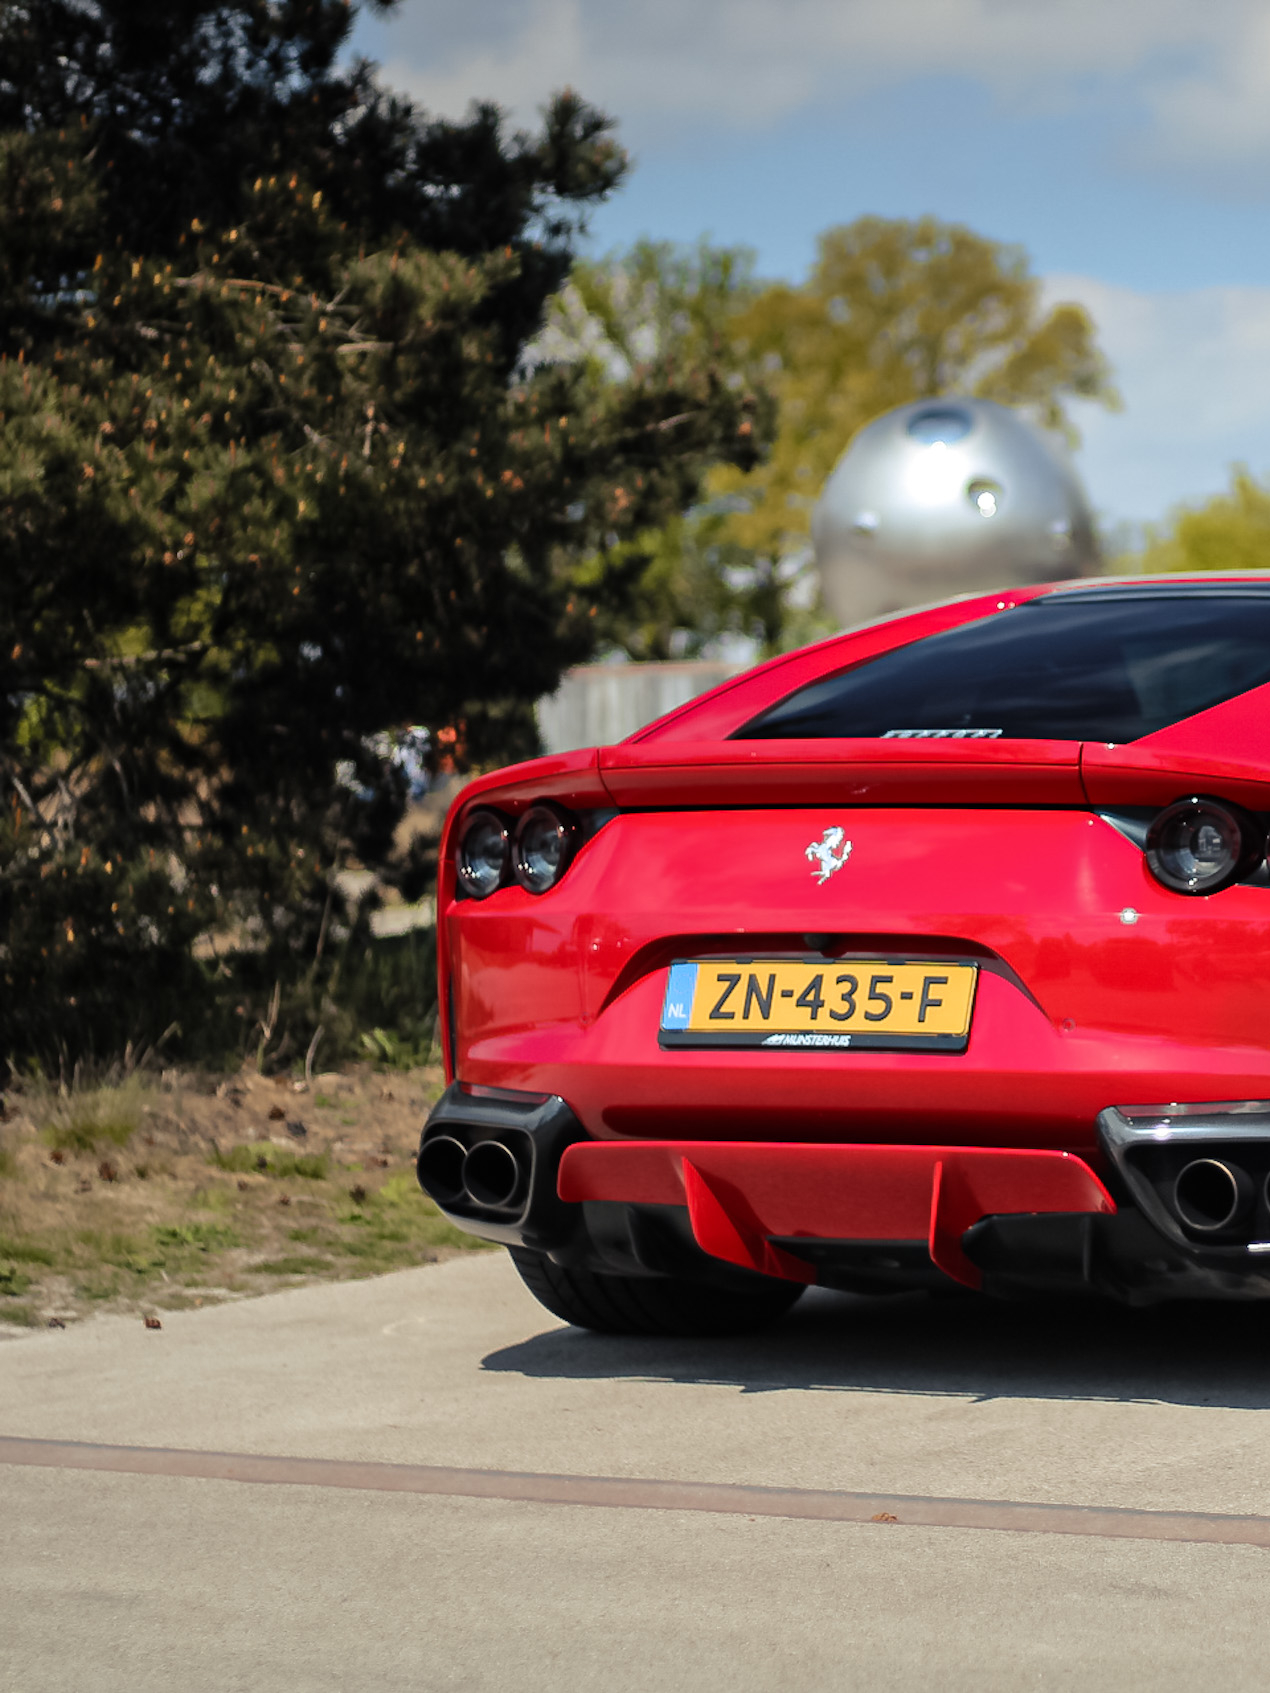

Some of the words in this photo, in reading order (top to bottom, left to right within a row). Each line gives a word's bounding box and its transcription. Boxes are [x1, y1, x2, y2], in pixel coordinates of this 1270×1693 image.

[708, 973, 949, 1023] ZN-435-F
[667, 1002, 687, 1018] NL
[782, 1034, 852, 1047] MUNSTERHUIS
